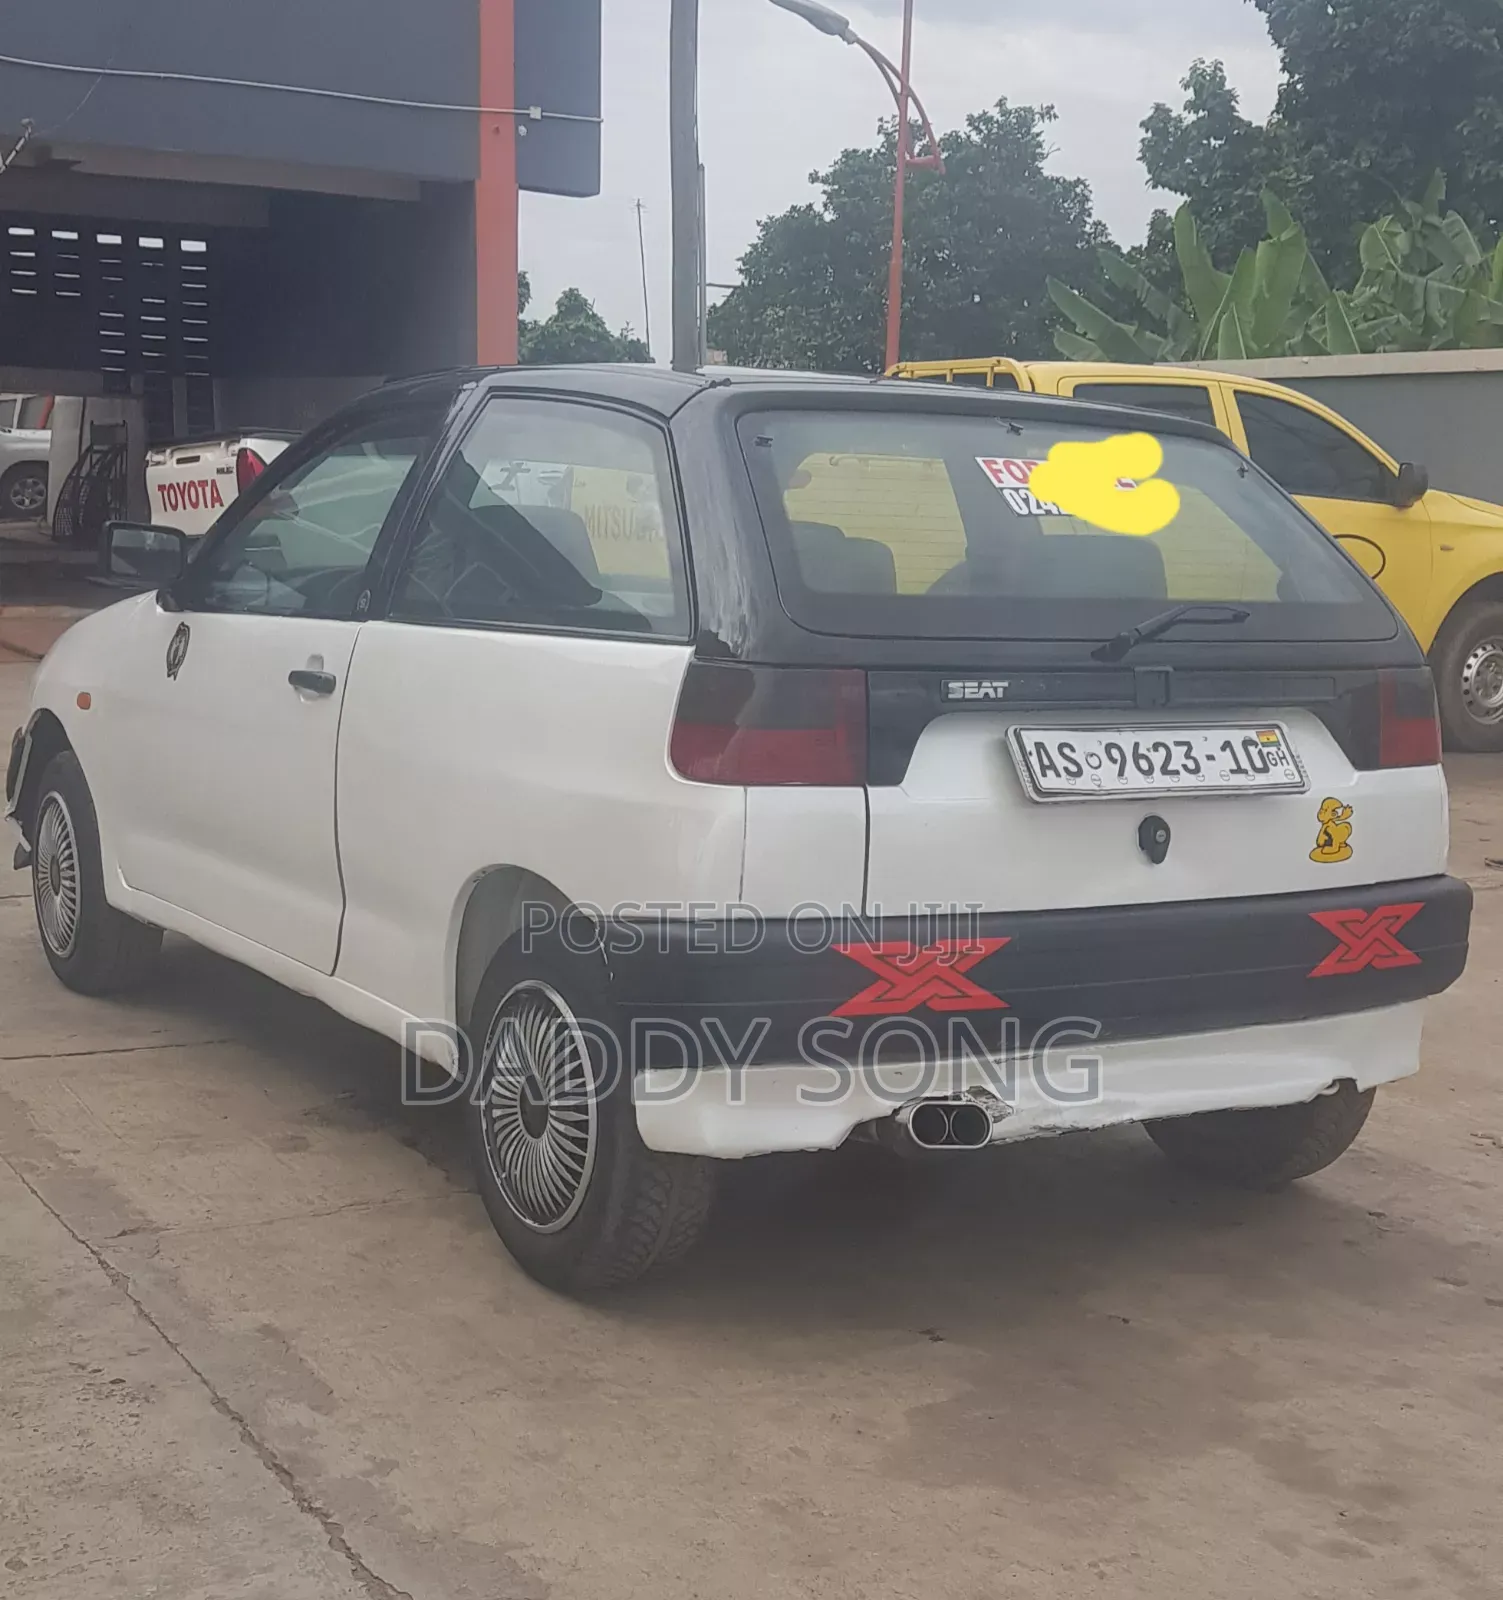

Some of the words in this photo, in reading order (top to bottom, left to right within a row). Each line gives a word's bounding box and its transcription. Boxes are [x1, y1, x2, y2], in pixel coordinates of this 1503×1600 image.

[157, 479, 224, 512] TOYOTA
[1002, 488, 1072, 515] 024
[947, 681, 1009, 699] SEAT
[1033, 741, 1084, 778] AS
